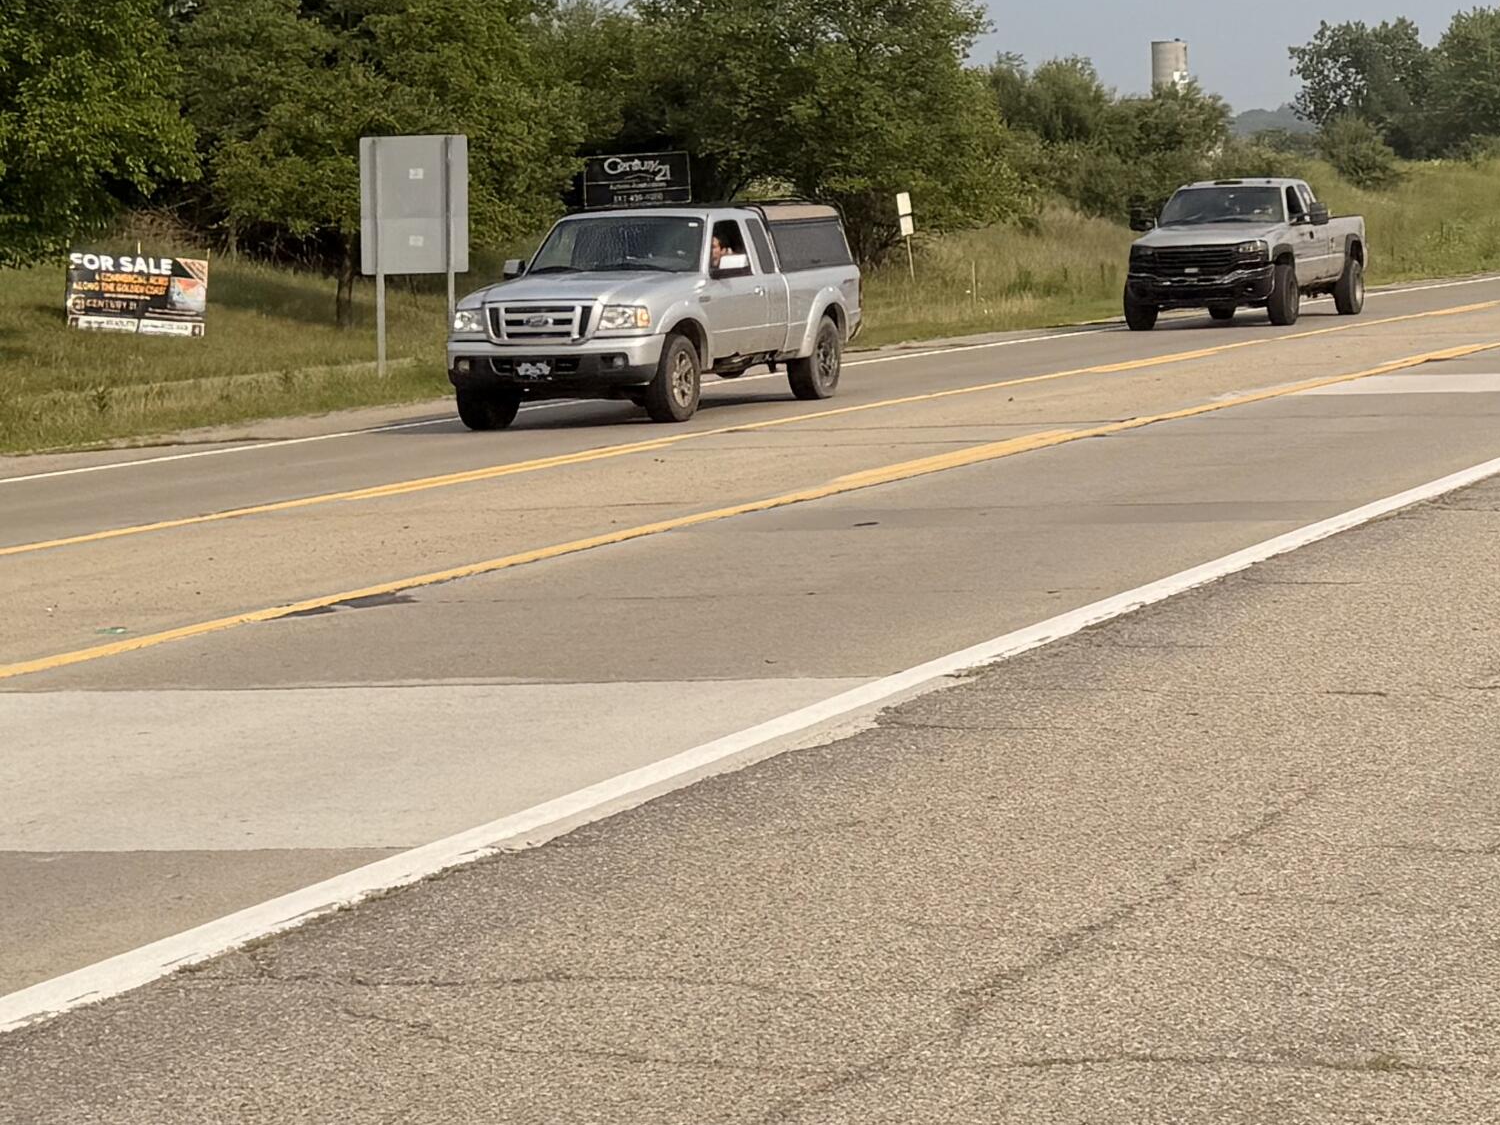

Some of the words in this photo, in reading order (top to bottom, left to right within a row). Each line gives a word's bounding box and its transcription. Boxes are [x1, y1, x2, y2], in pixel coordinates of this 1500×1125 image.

[603, 157, 660, 174] Century
[655, 164, 671, 181] 21
[69, 252, 114, 271] FOR
[119, 256, 173, 275] SALE
[86, 298, 127, 310] CENTURY
